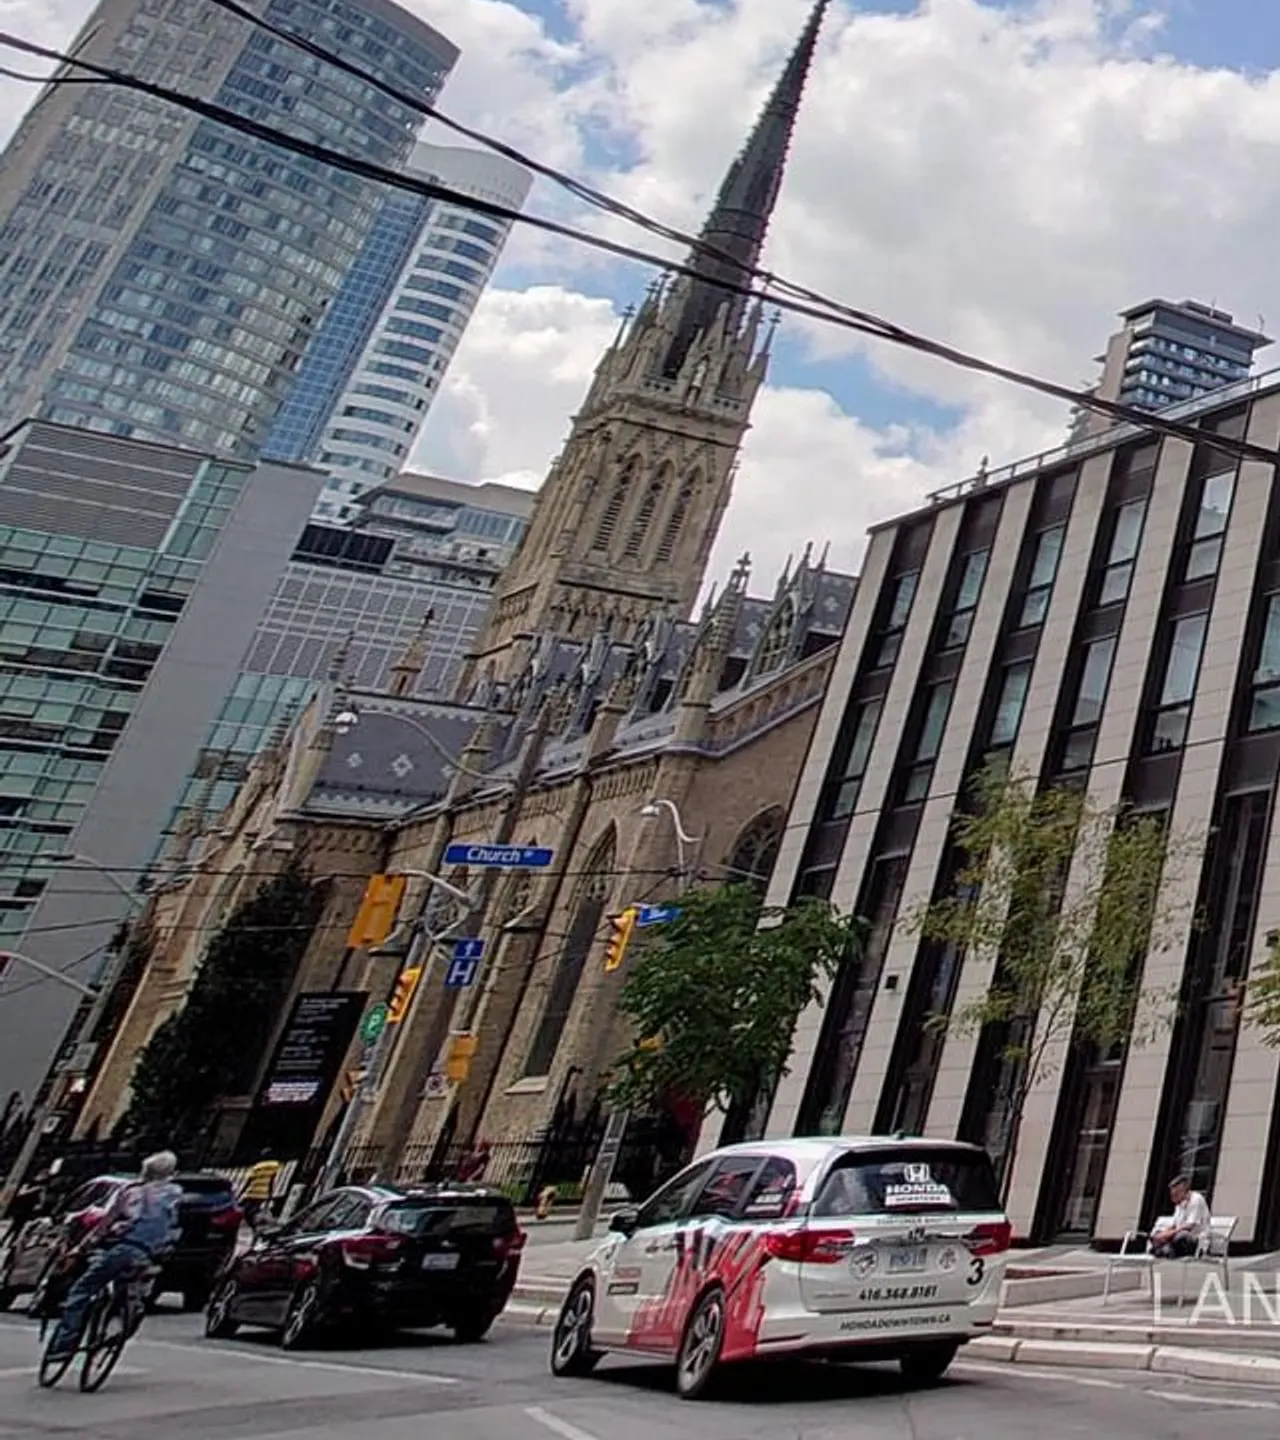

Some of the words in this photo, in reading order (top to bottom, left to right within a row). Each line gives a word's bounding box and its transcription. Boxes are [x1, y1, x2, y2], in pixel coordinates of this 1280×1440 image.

[466, 847, 520, 863] Church
[449, 961, 473, 983] H
[885, 1184, 949, 1194] HONDA
[967, 1257, 986, 1286] 3
[840, 1315, 951, 1330] HONDADOWNTOWN.CA
